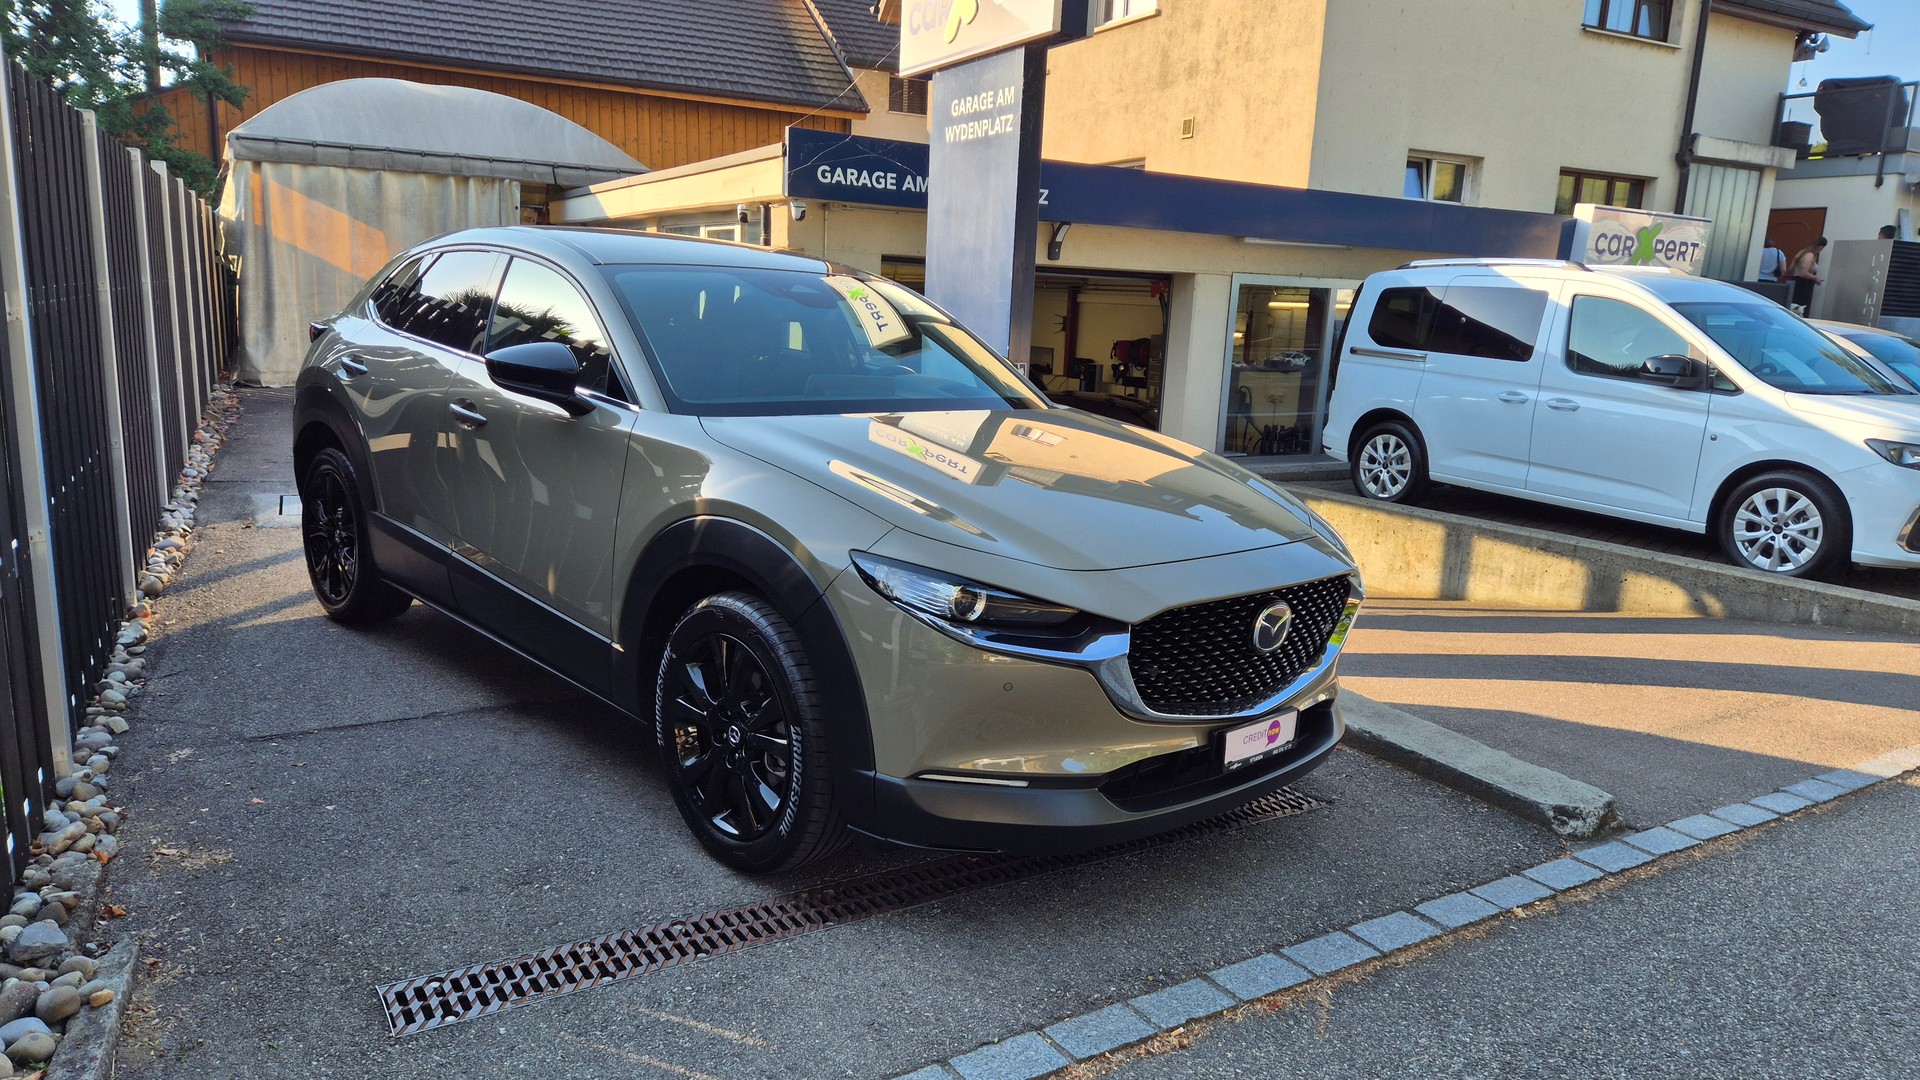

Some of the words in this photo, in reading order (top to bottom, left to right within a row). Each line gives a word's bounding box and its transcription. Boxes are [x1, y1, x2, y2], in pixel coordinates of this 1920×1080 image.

[951, 90, 994, 117] GARAGE
[996, 85, 1015, 108] AM
[945, 113, 1014, 143] WYDENPLATZ
[816, 165, 897, 190] GARAGE
[902, 175, 930, 193] AM
[779, 724, 803, 840] BRIDGESTONE
